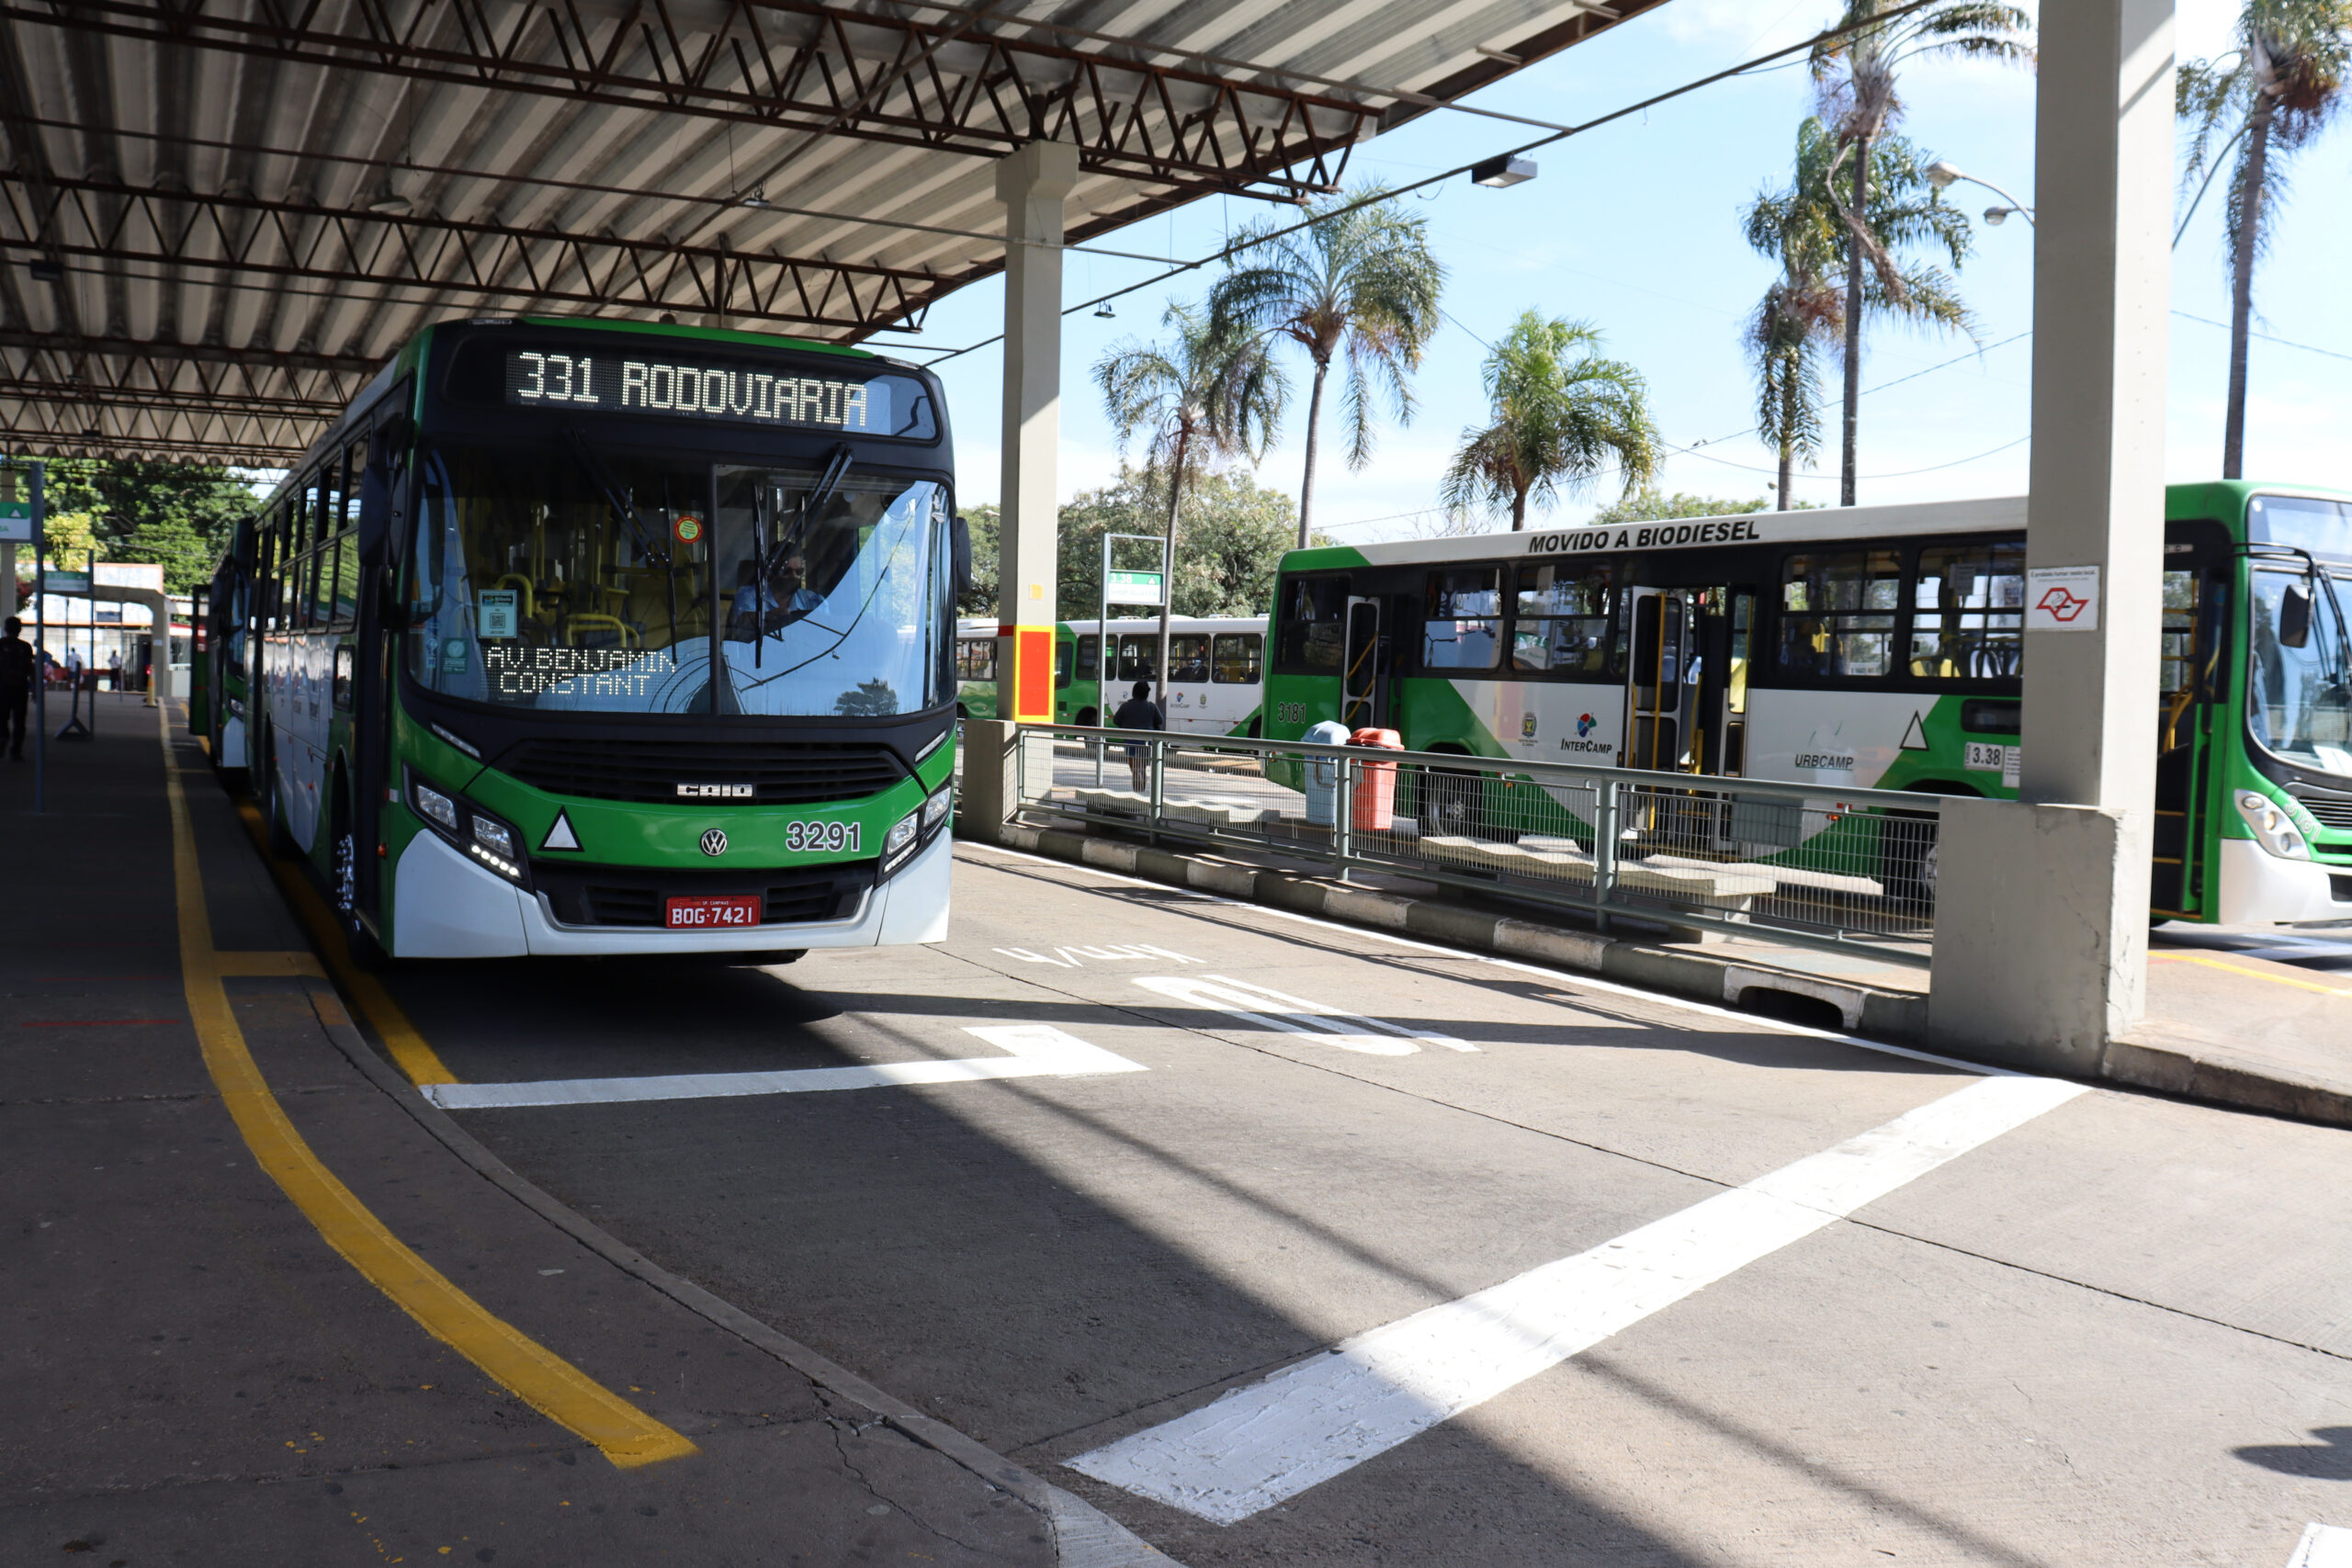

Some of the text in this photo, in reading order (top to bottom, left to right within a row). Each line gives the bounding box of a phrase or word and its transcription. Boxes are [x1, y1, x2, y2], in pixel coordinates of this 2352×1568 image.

[518, 352, 599, 402] 331
[1529, 521, 1760, 553] MOVIDO A BIODIESEL
[500, 671, 650, 695] CONSTANT
[1278, 701, 1306, 724] 3181
[1794, 753, 1854, 770] URBCAMP
[1973, 746, 2001, 766] 3.38
[677, 784, 752, 796] CAIO
[2284, 794, 2323, 843] 3181
[786, 820, 861, 852] 3291
